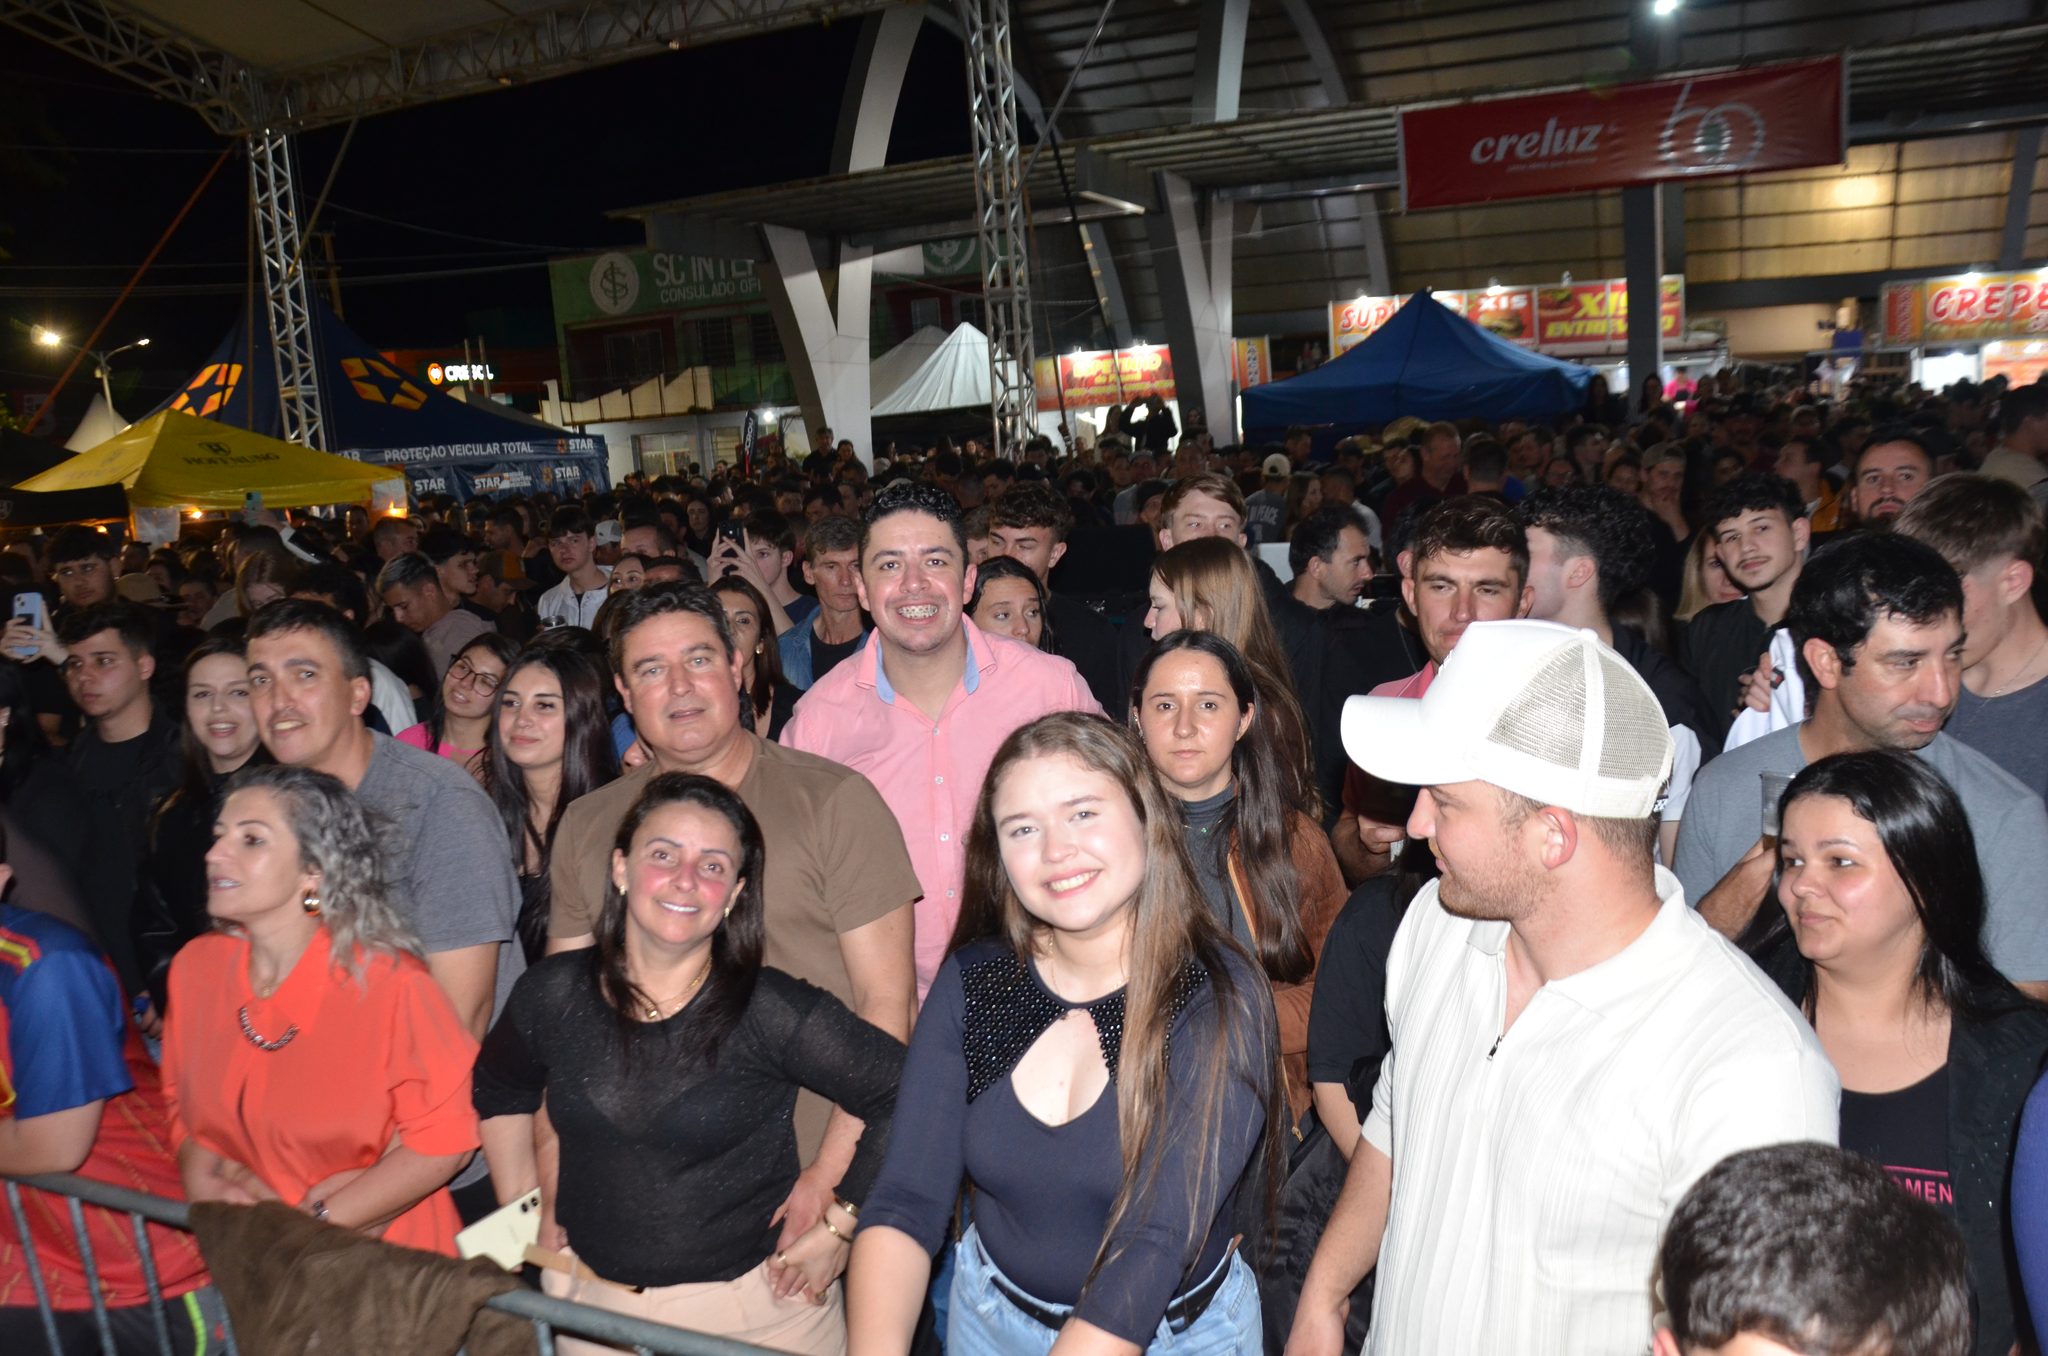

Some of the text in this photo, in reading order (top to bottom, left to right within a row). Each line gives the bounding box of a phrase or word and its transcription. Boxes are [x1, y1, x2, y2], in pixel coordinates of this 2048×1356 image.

[1470, 116, 1604, 165] creluz
[652, 253, 685, 287] SC
[660, 279, 735, 304] CONSULADO
[1479, 294, 1527, 311] XIS
[448, 442, 500, 457] VEICULAR
[501, 441, 534, 454] TOTAL
[568, 438, 594, 451] STAR
[554, 466, 580, 479] STAR
[414, 478, 446, 492] STAR
[474, 477, 501, 491] STAR
[1893, 1175, 1953, 1206] MEN
